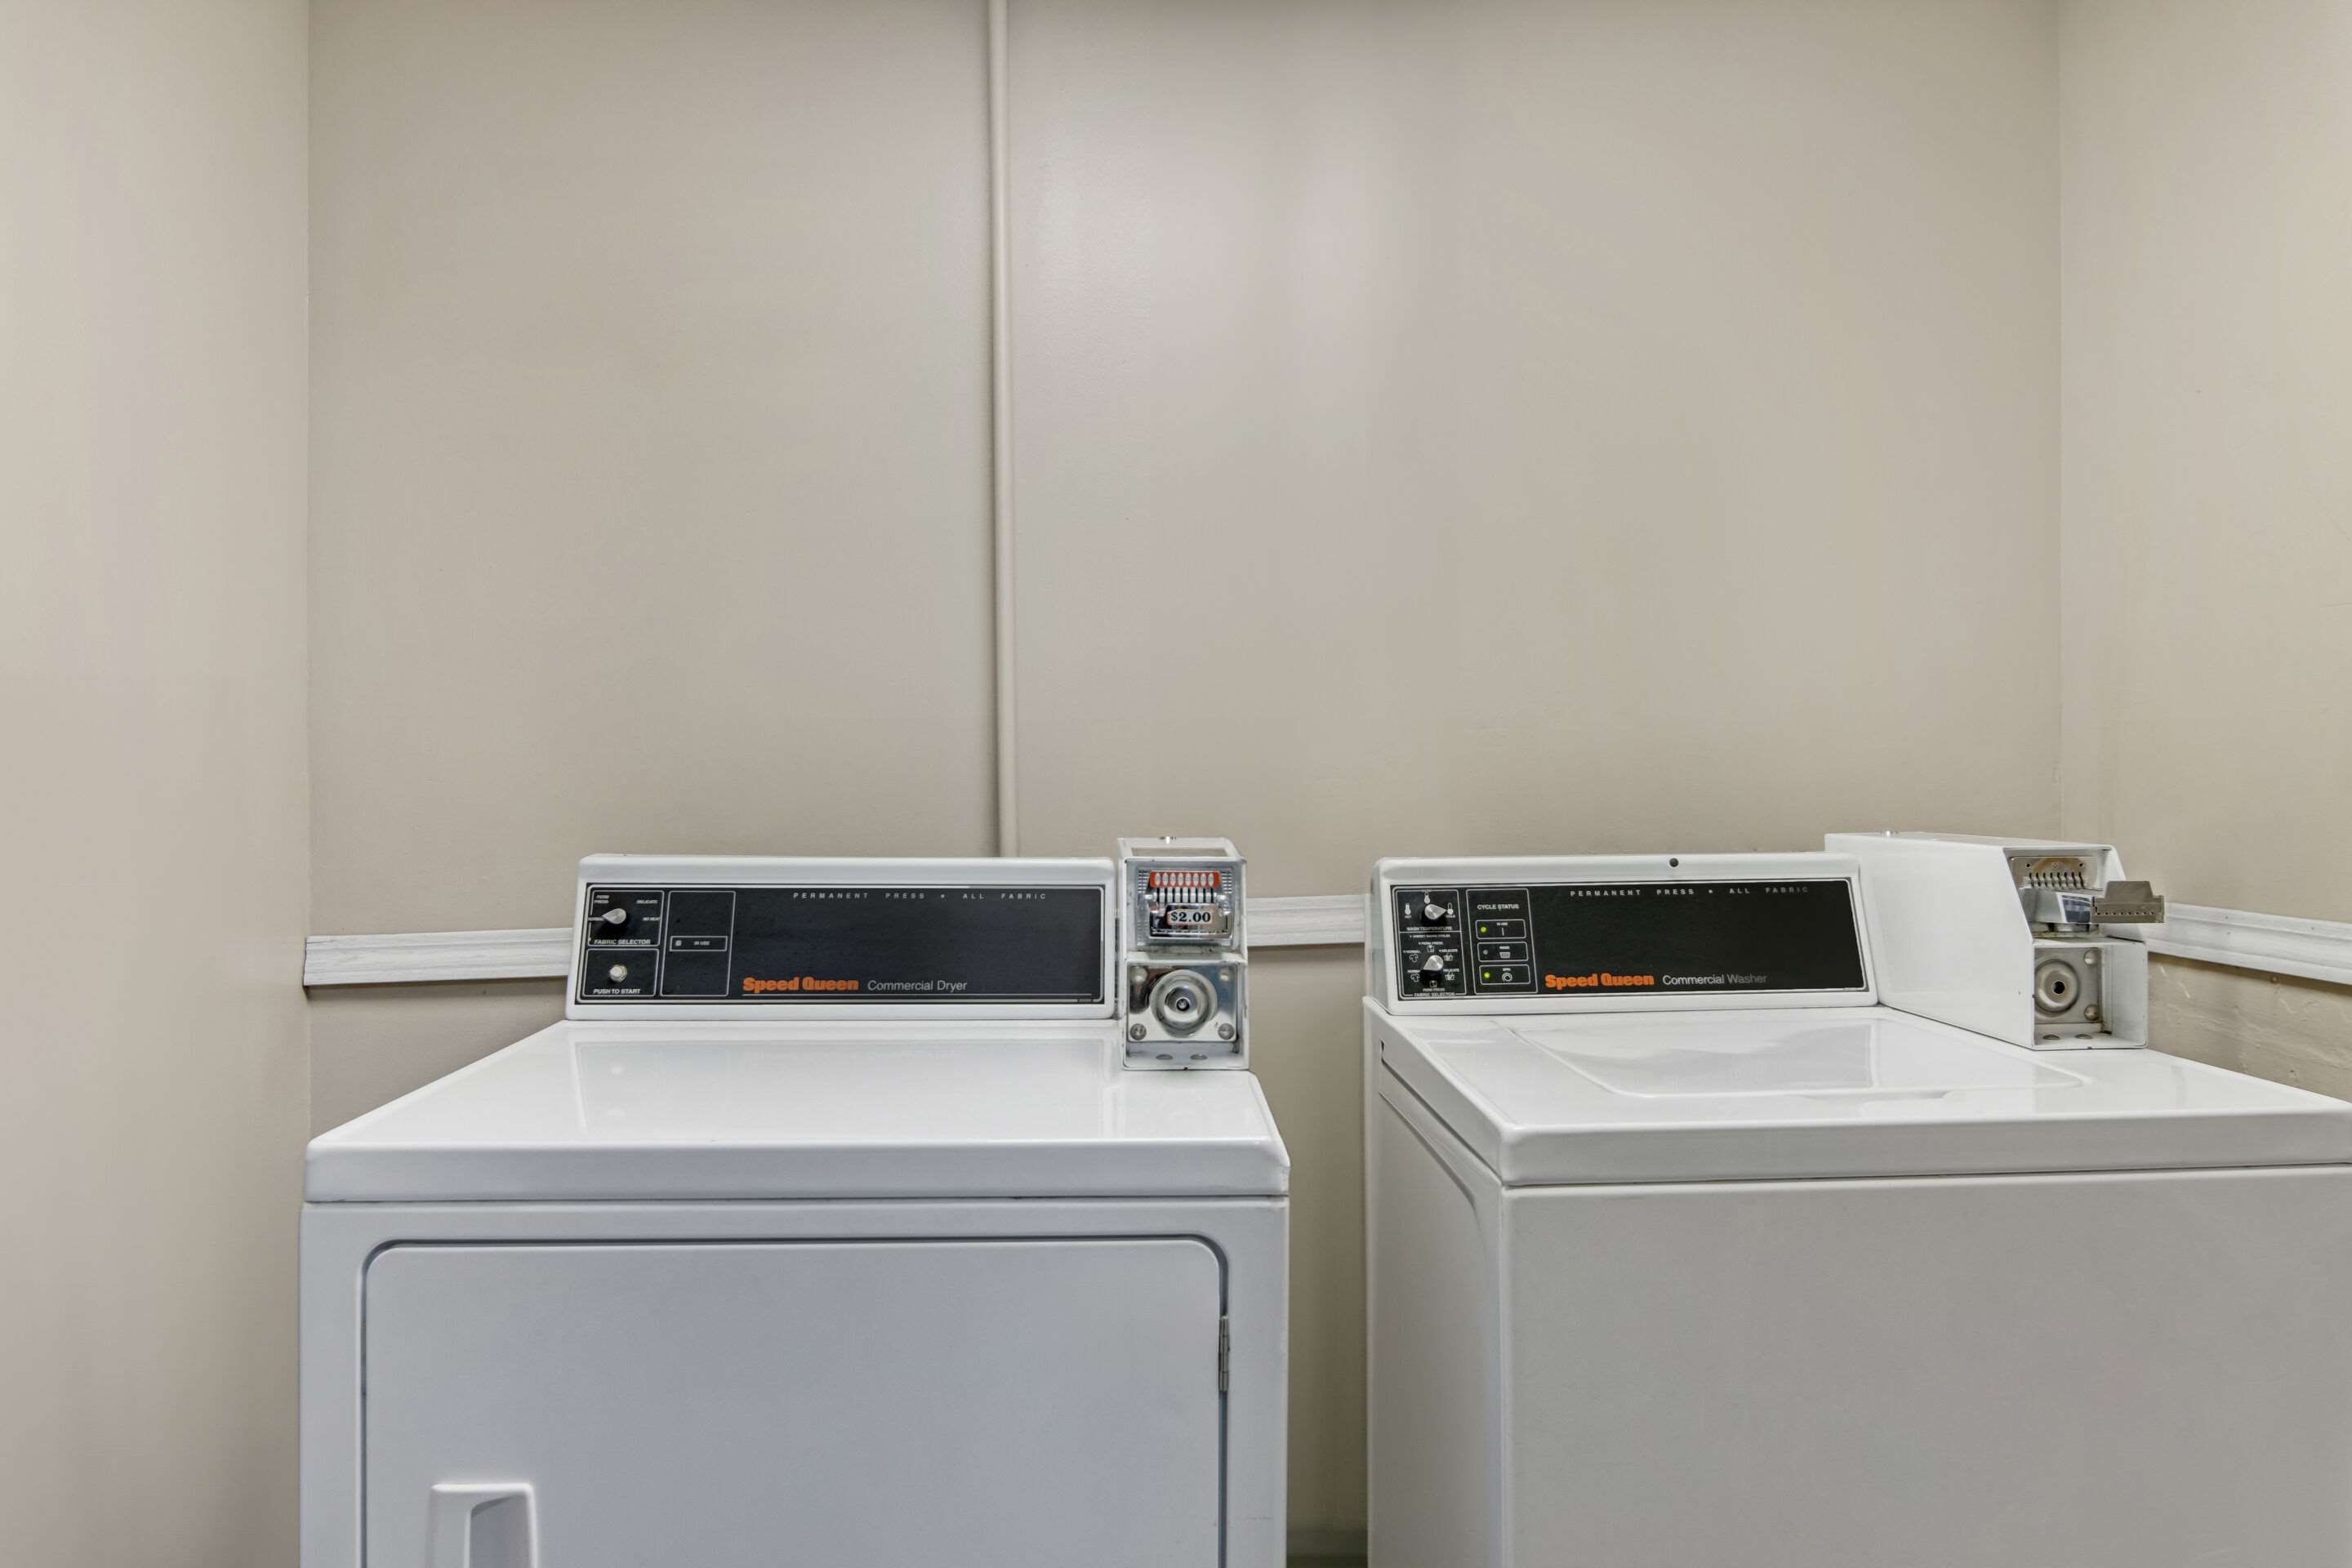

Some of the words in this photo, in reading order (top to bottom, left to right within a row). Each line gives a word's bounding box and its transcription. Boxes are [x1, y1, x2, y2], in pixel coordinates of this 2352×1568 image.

[1170, 911, 1211, 922] $2.00
[742, 977, 799, 993] Speed
[802, 977, 859, 991] Queen
[867, 980, 933, 991] Commercial
[937, 980, 968, 992] Dryer
[1544, 974, 1598, 990] Speed
[1600, 973, 1655, 987] Queen
[1662, 974, 1725, 986] Commercial
[1726, 974, 1767, 985] Washer
